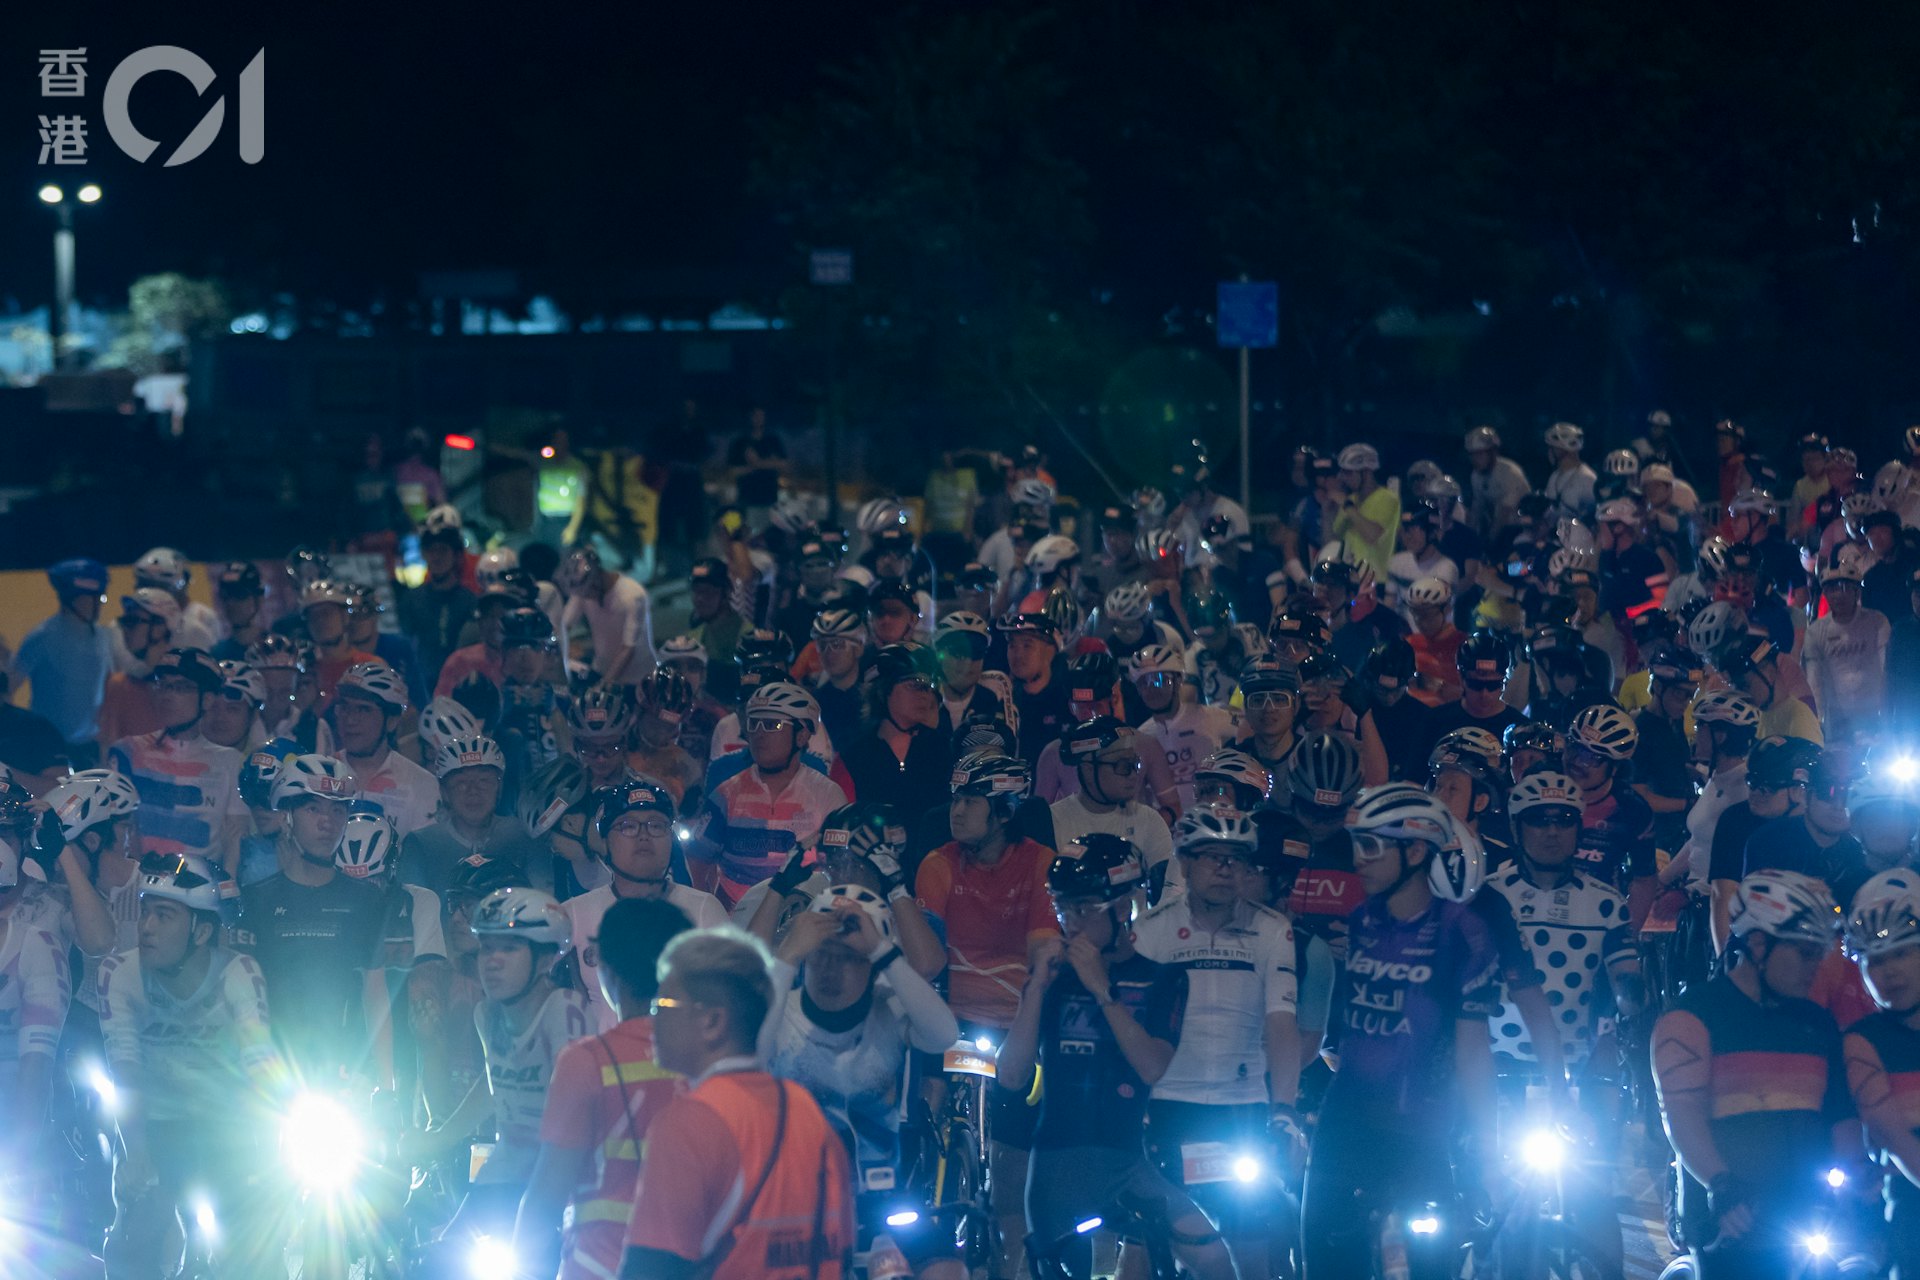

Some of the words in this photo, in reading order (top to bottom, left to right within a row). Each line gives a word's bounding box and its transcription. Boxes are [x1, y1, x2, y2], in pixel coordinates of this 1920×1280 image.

[1172, 947, 1252, 961] intimissimi
[1195, 960, 1230, 969] UOMO
[954, 1054, 987, 1069] 2820
